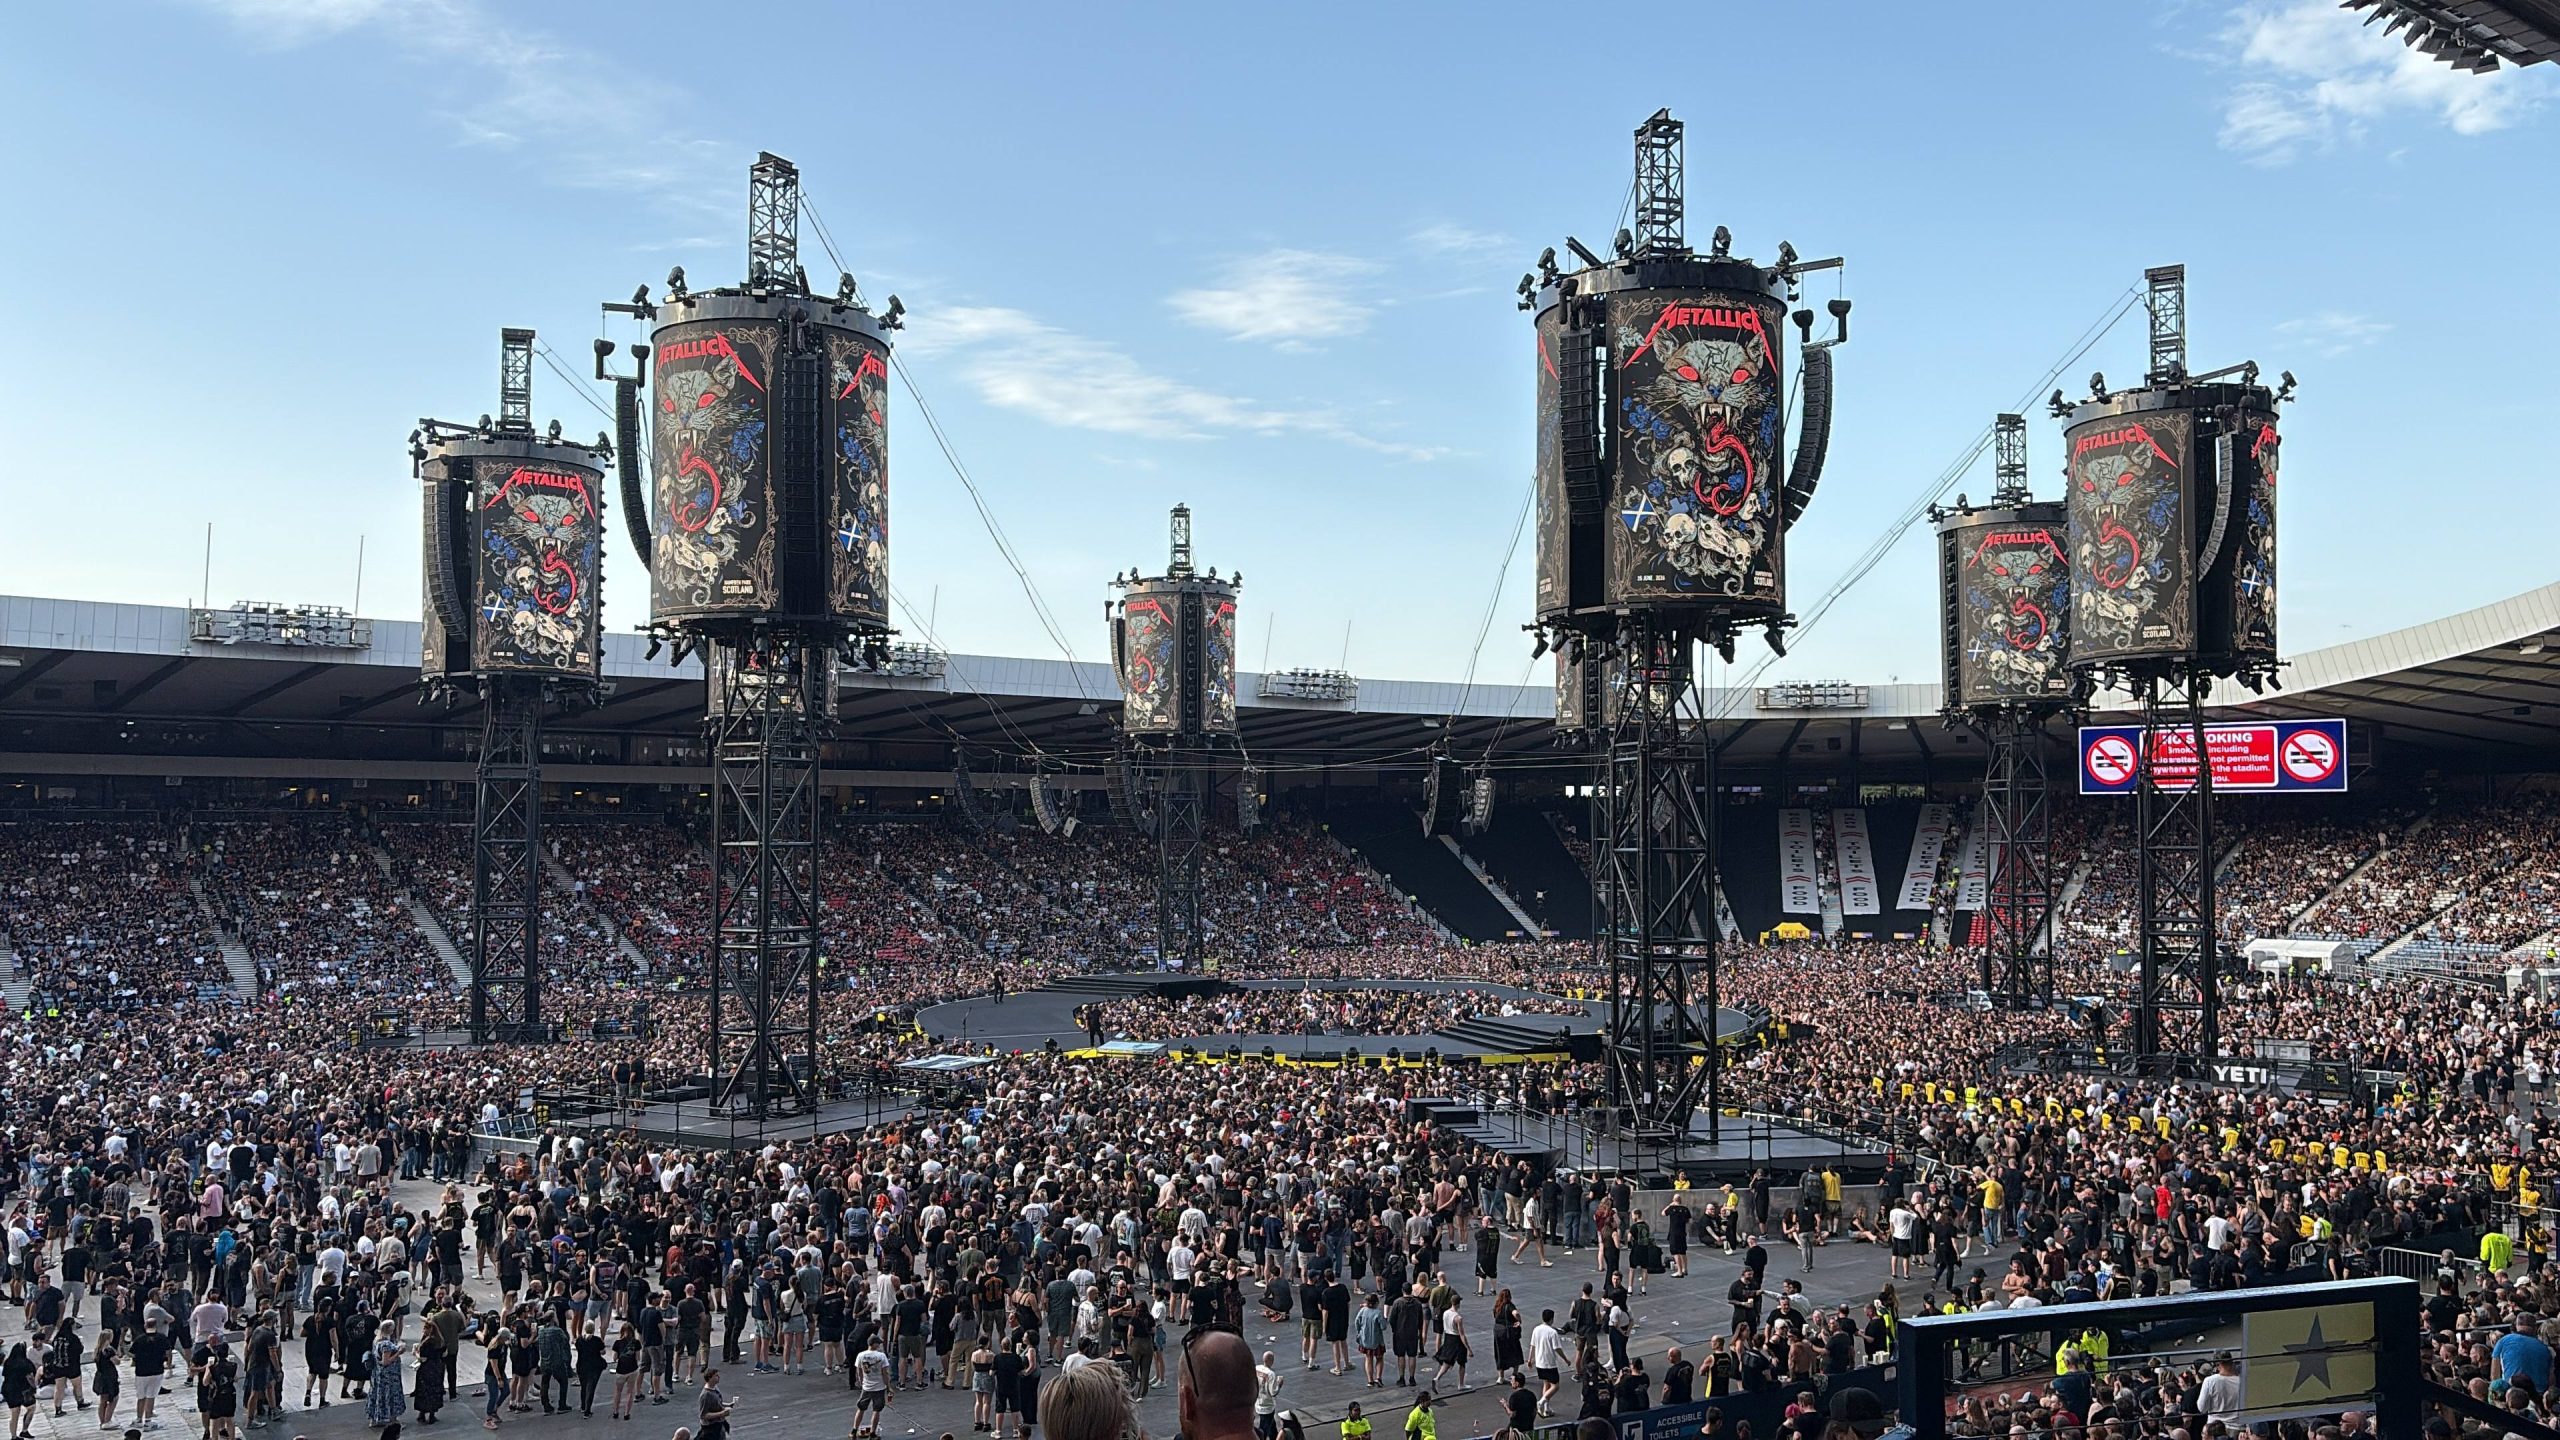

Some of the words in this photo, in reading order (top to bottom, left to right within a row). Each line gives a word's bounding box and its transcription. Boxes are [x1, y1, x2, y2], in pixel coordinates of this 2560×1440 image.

[1624, 299, 1777, 377] METALLICA
[656, 331, 764, 392] METALLICA
[2069, 422, 2178, 484] METALLICA
[483, 465, 595, 520] METALLICA
[1967, 528, 2069, 570] METALLICA
[722, 585, 753, 594] SCOTLAND
[2142, 630, 2170, 638] SCOTLAND
[2186, 732, 2253, 744] SOKING
[2208, 745, 2249, 755] including
[2210, 755, 2225, 763] not
[2227, 754, 2269, 764] permitted
[2216, 764, 2231, 772] the
[2233, 763, 2270, 772] stadium.
[1790, 841, 1804, 873] TOILETS
[1846, 841, 1863, 873] TOILETS
[1920, 837, 1939, 869] TOILETS
[1792, 886, 1808, 906] FOOD
[1852, 887, 1869, 907] FOOD
[1909, 882, 1928, 903] FOOD
[1967, 882, 1984, 903] FOOD
[2213, 1065, 2267, 1084] YETI
[1657, 1411, 1702, 1428] ACCESSIBLE
[1649, 1428, 1679, 1440] TOILETS
